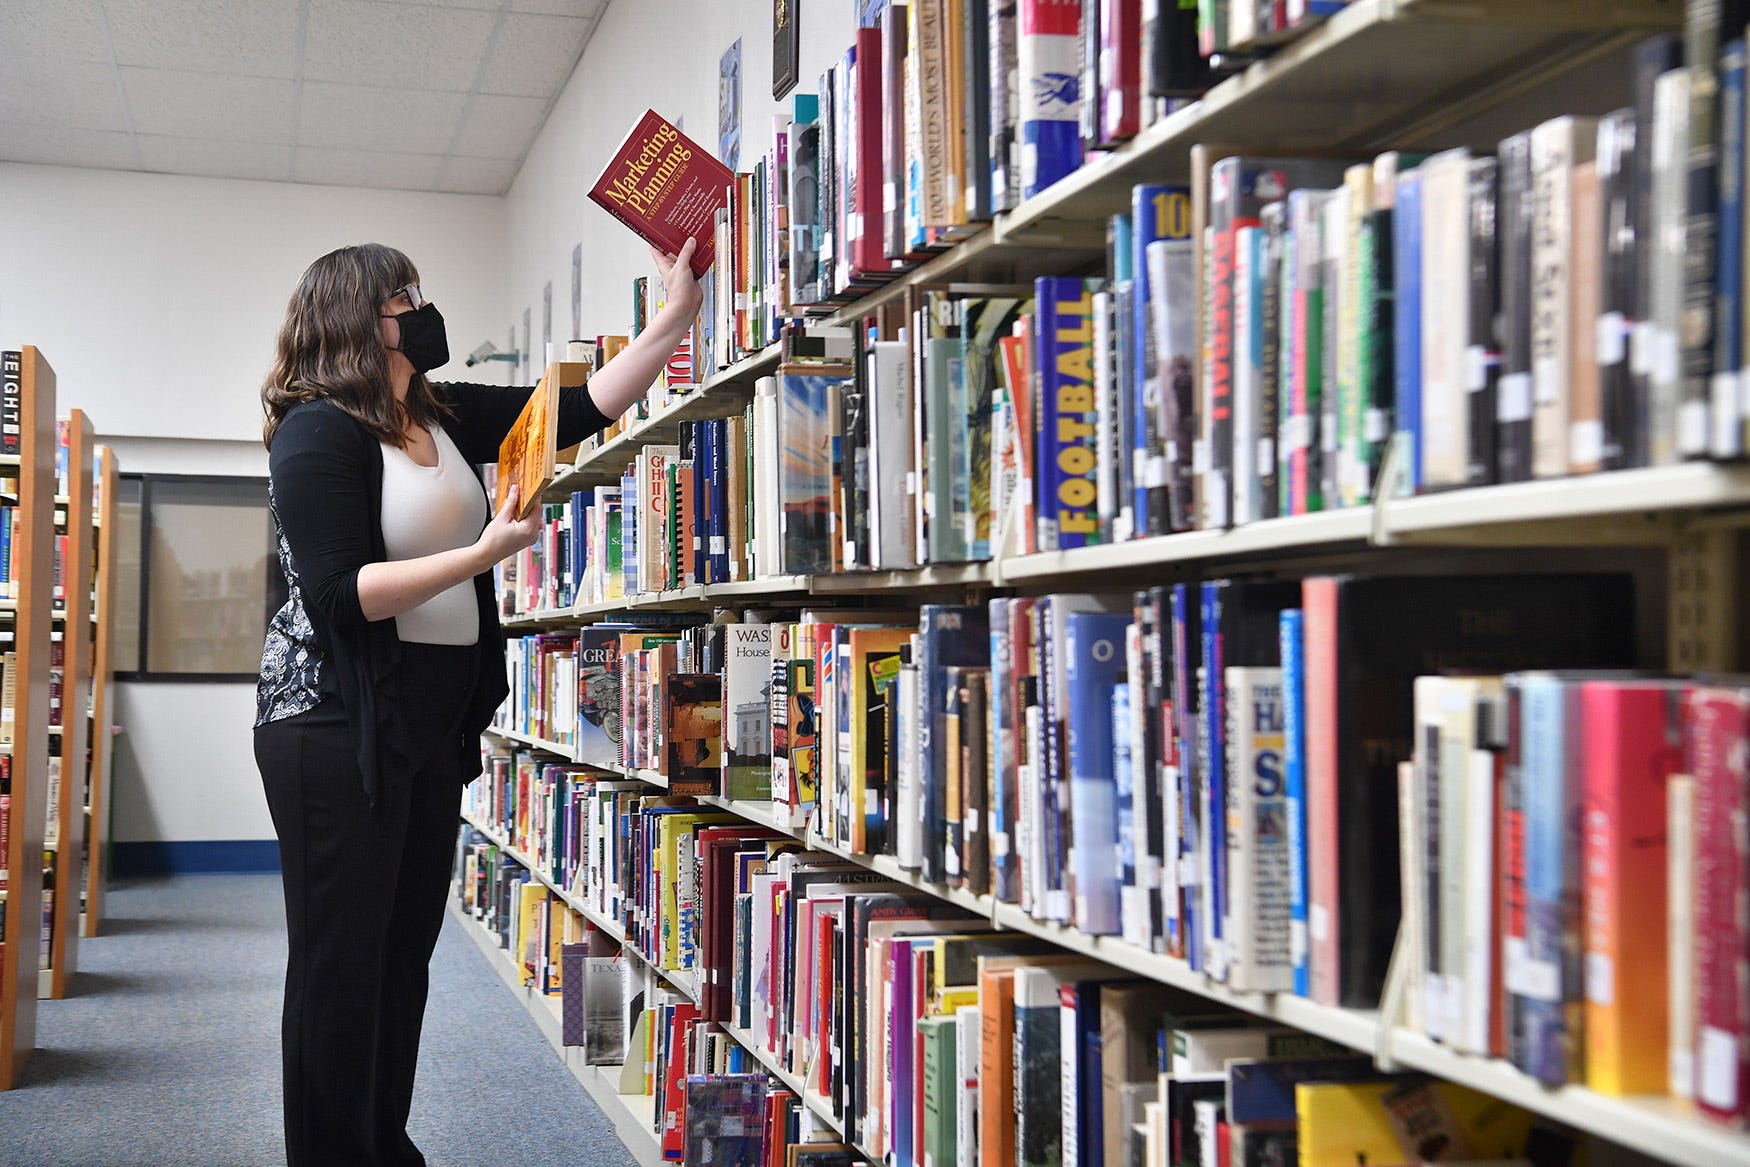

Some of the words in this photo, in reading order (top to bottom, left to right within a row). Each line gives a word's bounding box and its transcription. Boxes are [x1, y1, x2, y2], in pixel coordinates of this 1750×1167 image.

[924, 58, 941, 103] MOST
[605, 122, 678, 208] Marketing
[674, 163, 689, 184] GUIDE
[627, 143, 692, 216] Planning
[1153, 193, 1190, 238] 10
[939, 302, 960, 326] RI
[4, 361, 20, 422] EIGHT
[1056, 294, 1097, 534] FOOTBALL
[651, 455, 665, 468] GO
[651, 468, 665, 481] HO
[651, 496, 662, 512] C
[611, 537, 621, 545] Sc
[736, 629, 772, 643] WAS
[583, 648, 617, 663] GRE
[736, 646, 771, 657] House
[591, 965, 621, 973] TEXA
